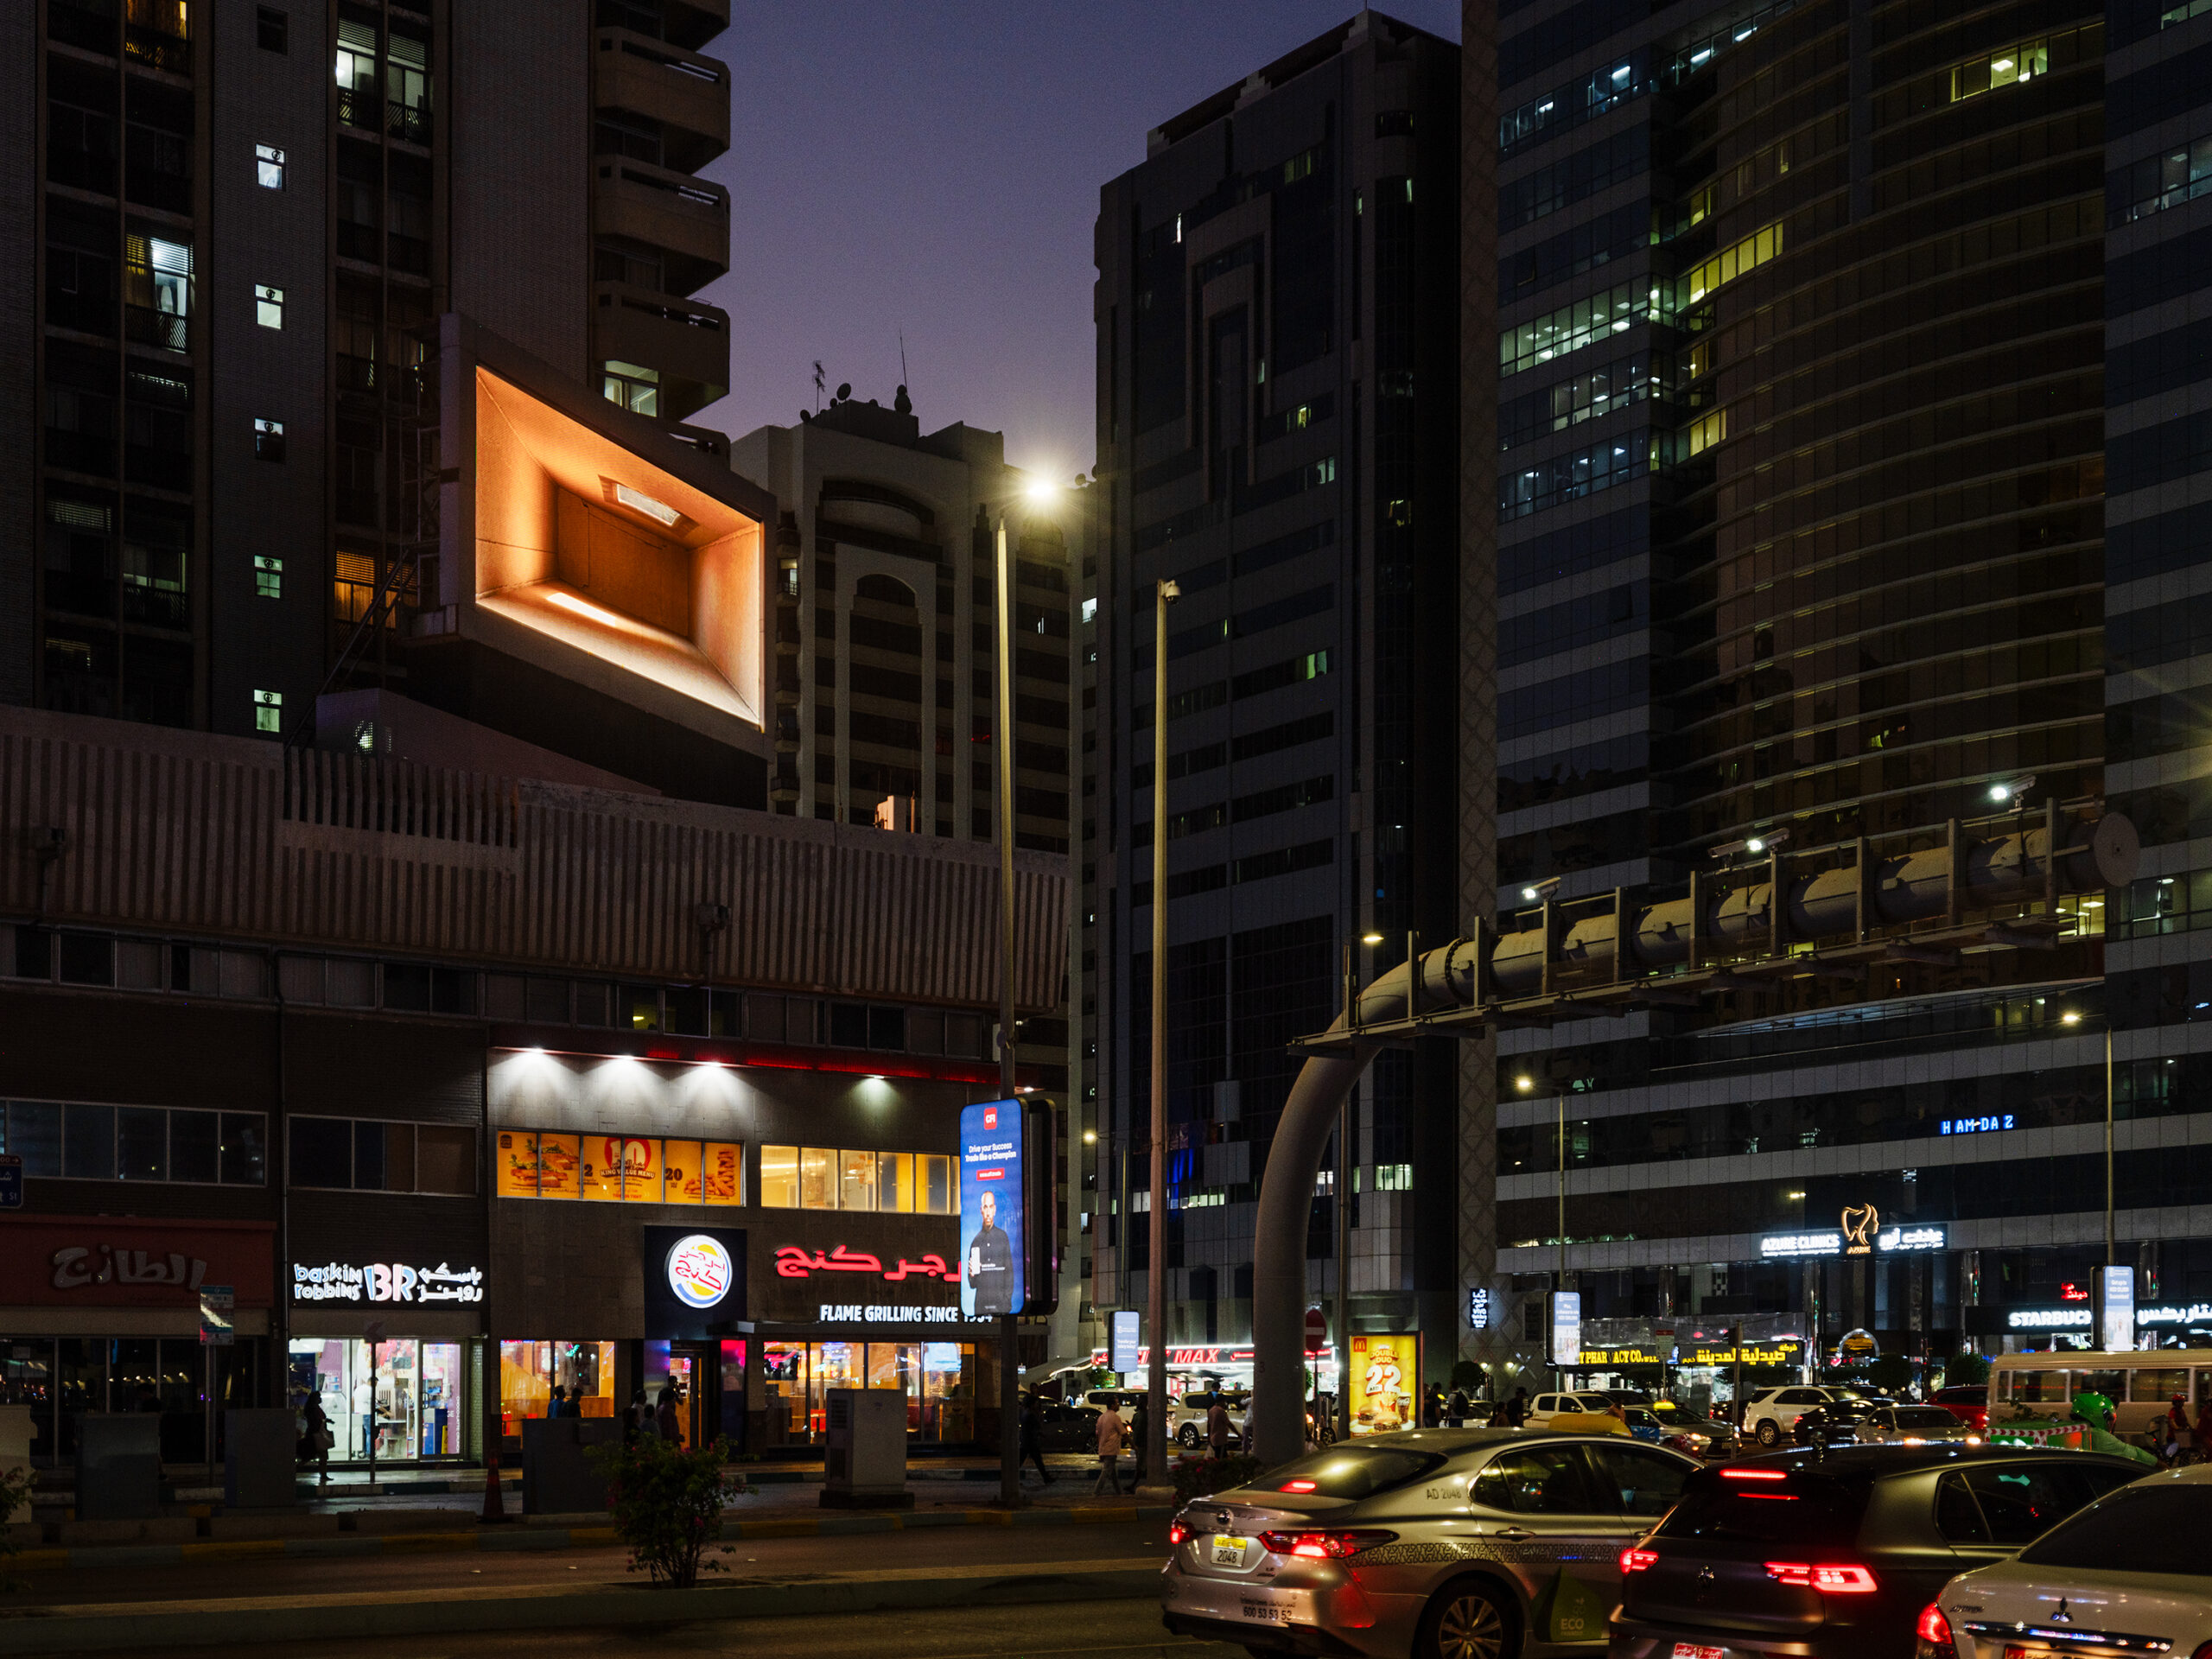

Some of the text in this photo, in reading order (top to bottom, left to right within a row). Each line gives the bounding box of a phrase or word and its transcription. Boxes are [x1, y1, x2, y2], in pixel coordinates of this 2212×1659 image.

[992, 1142, 1013, 1151] Success
[992, 1150, 1016, 1160] Champion
[665, 1168, 683, 1181] 20
[1761, 1235, 1840, 1251] AZURE CLINICS
[53, 1244, 207, 1290] الطازج
[777, 1244, 962, 1281] رجر كنج
[294, 1262, 362, 1284] baskin
[363, 1262, 417, 1301] BR
[294, 1283, 361, 1300] robbins
[820, 1305, 862, 1322] FLAME
[864, 1306, 922, 1322] GRILLING
[924, 1306, 958, 1322] SINCE
[2137, 1304, 2212, 1325] تاربكس
[1173, 1348, 1220, 1364] MAX
[1370, 1349, 1397, 1359] DOUBLE
[1585, 1351, 1630, 1364] PHARACY
[1696, 1347, 1737, 1366] لمدينة
[1366, 1364, 1401, 1394] 22
[1427, 1488, 1462, 1500] AD 2048
[1217, 1549, 1237, 1563] 2048
[1258, 1608, 1267, 1618] 53
[1268, 1609, 1279, 1619] 53
[1560, 1618, 1584, 1630] ECO
